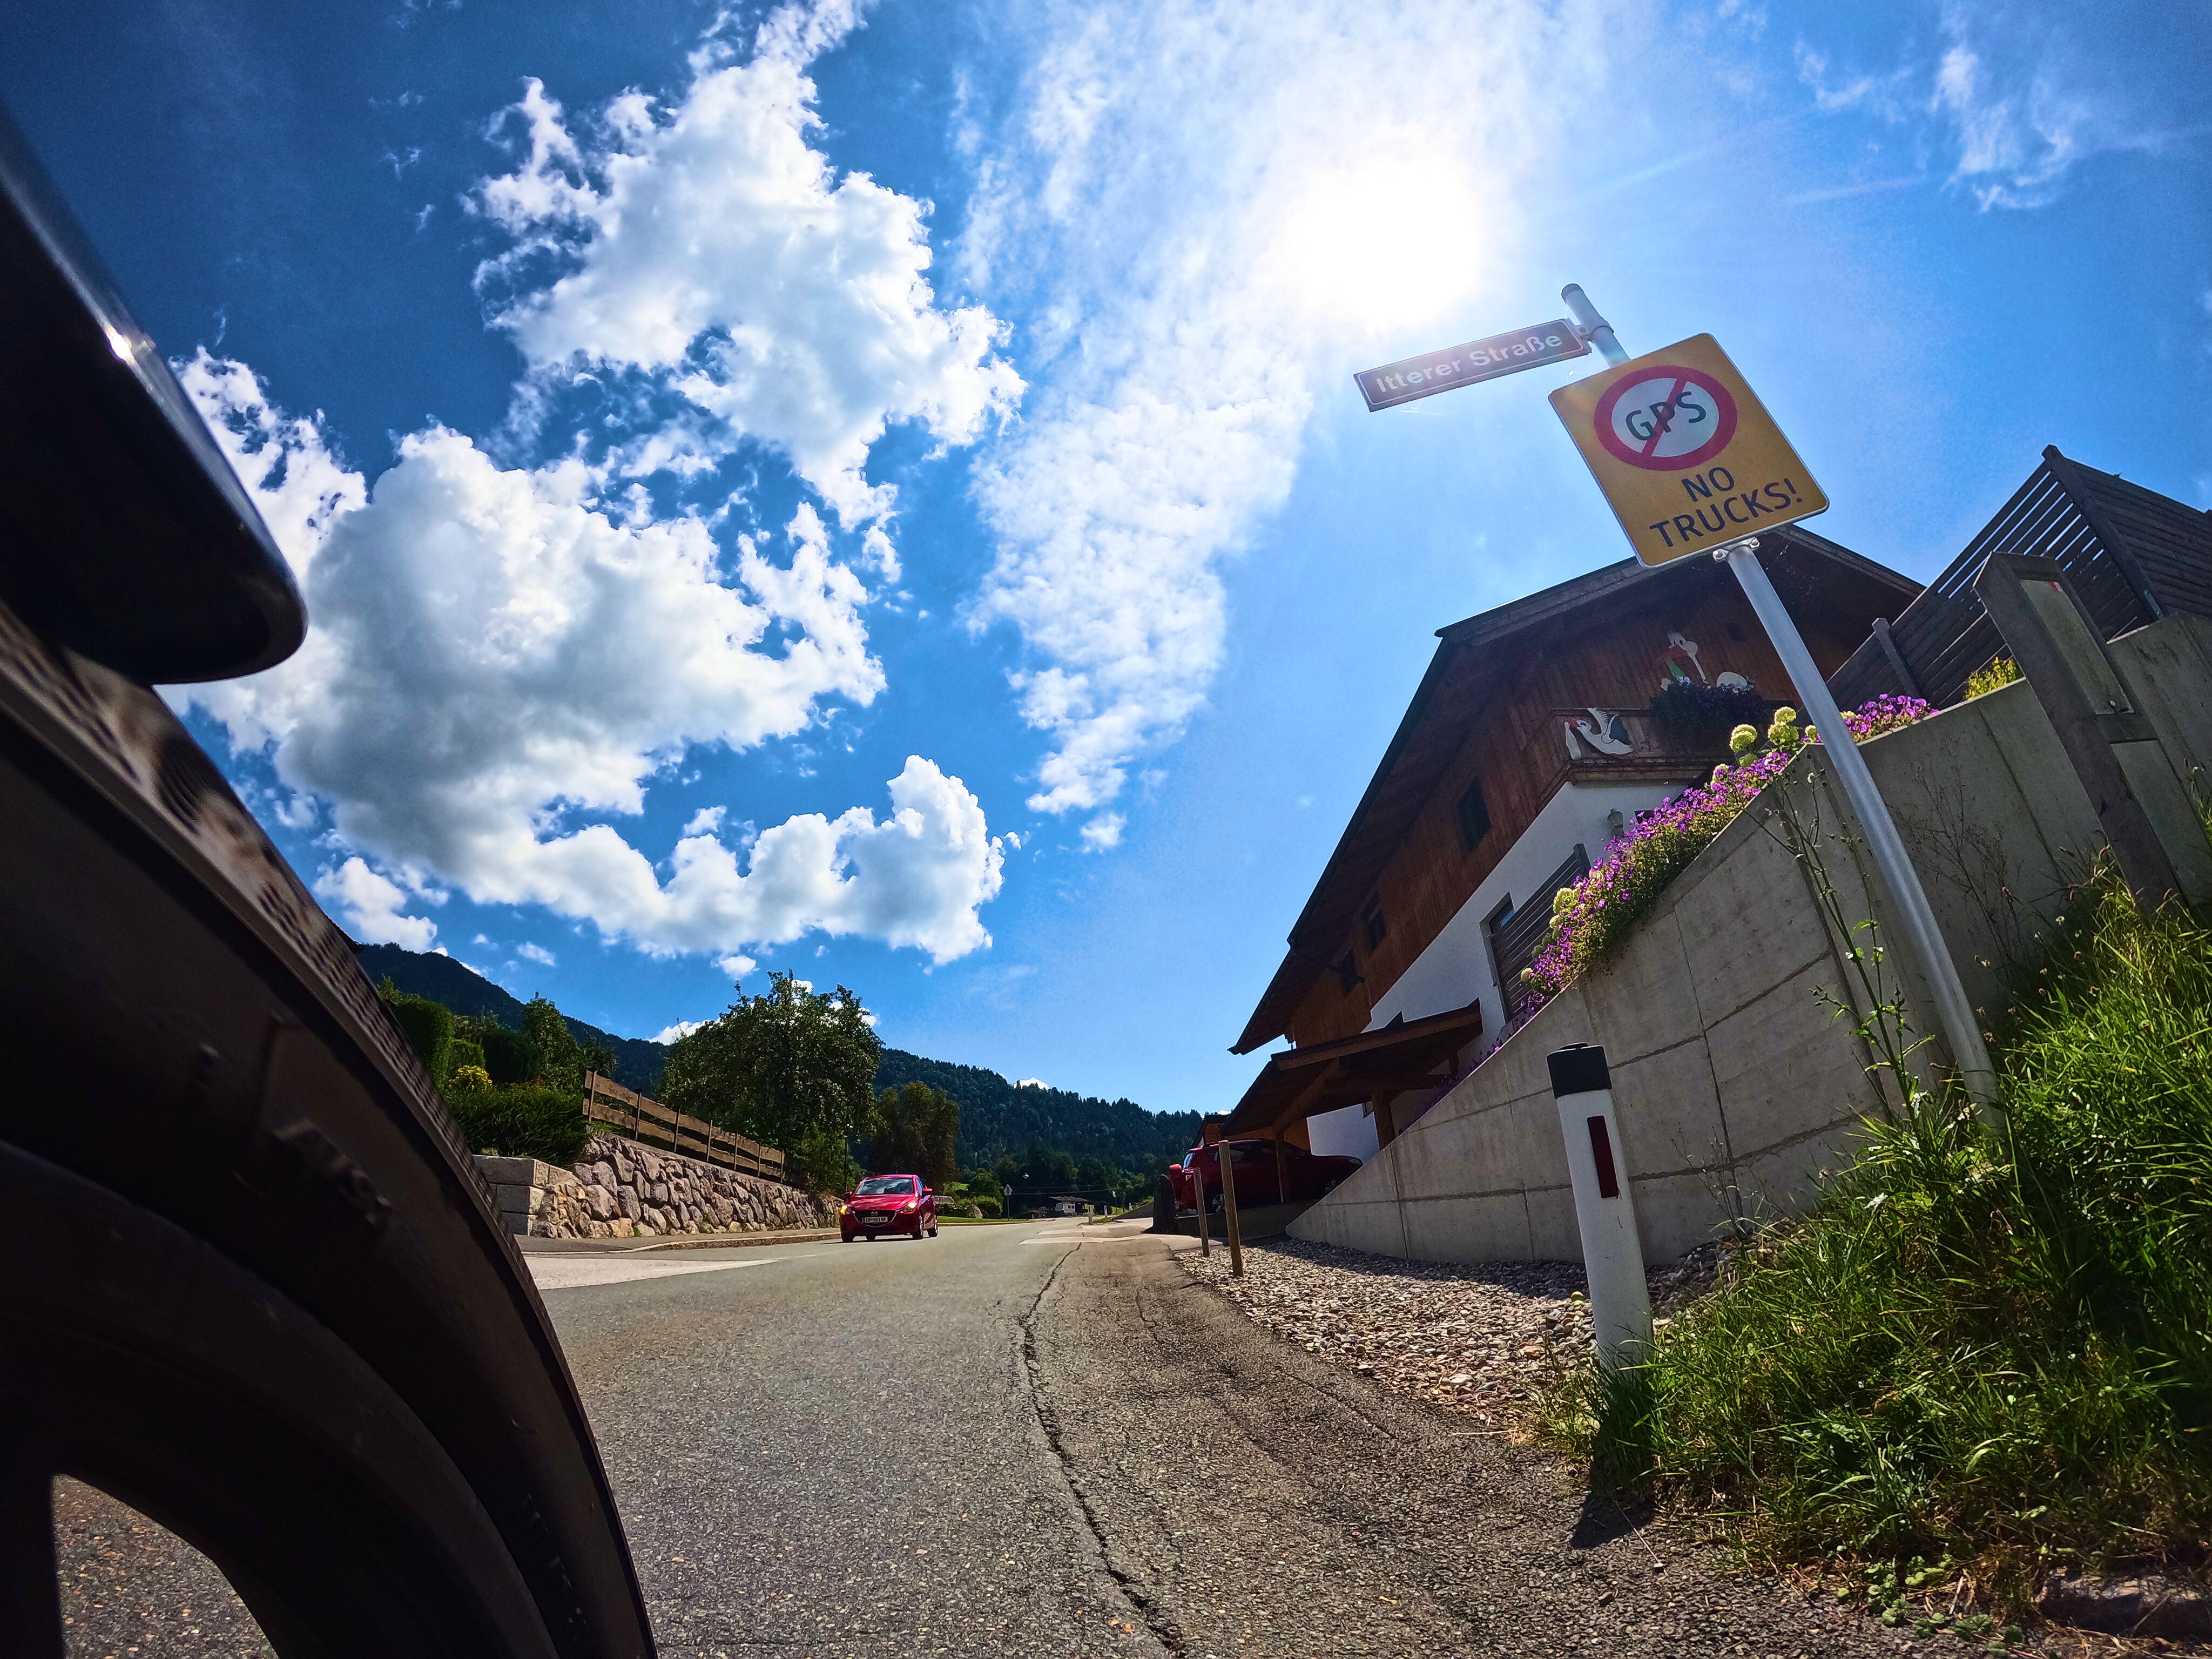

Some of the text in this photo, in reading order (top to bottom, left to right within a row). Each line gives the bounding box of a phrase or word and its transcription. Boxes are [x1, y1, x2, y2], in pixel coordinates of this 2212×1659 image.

[1375, 335, 1563, 393] Itterer Straße
[1625, 391, 1707, 441] GPS
[1681, 467, 1735, 502] NO
[1649, 477, 1803, 548] TRUCKS!
